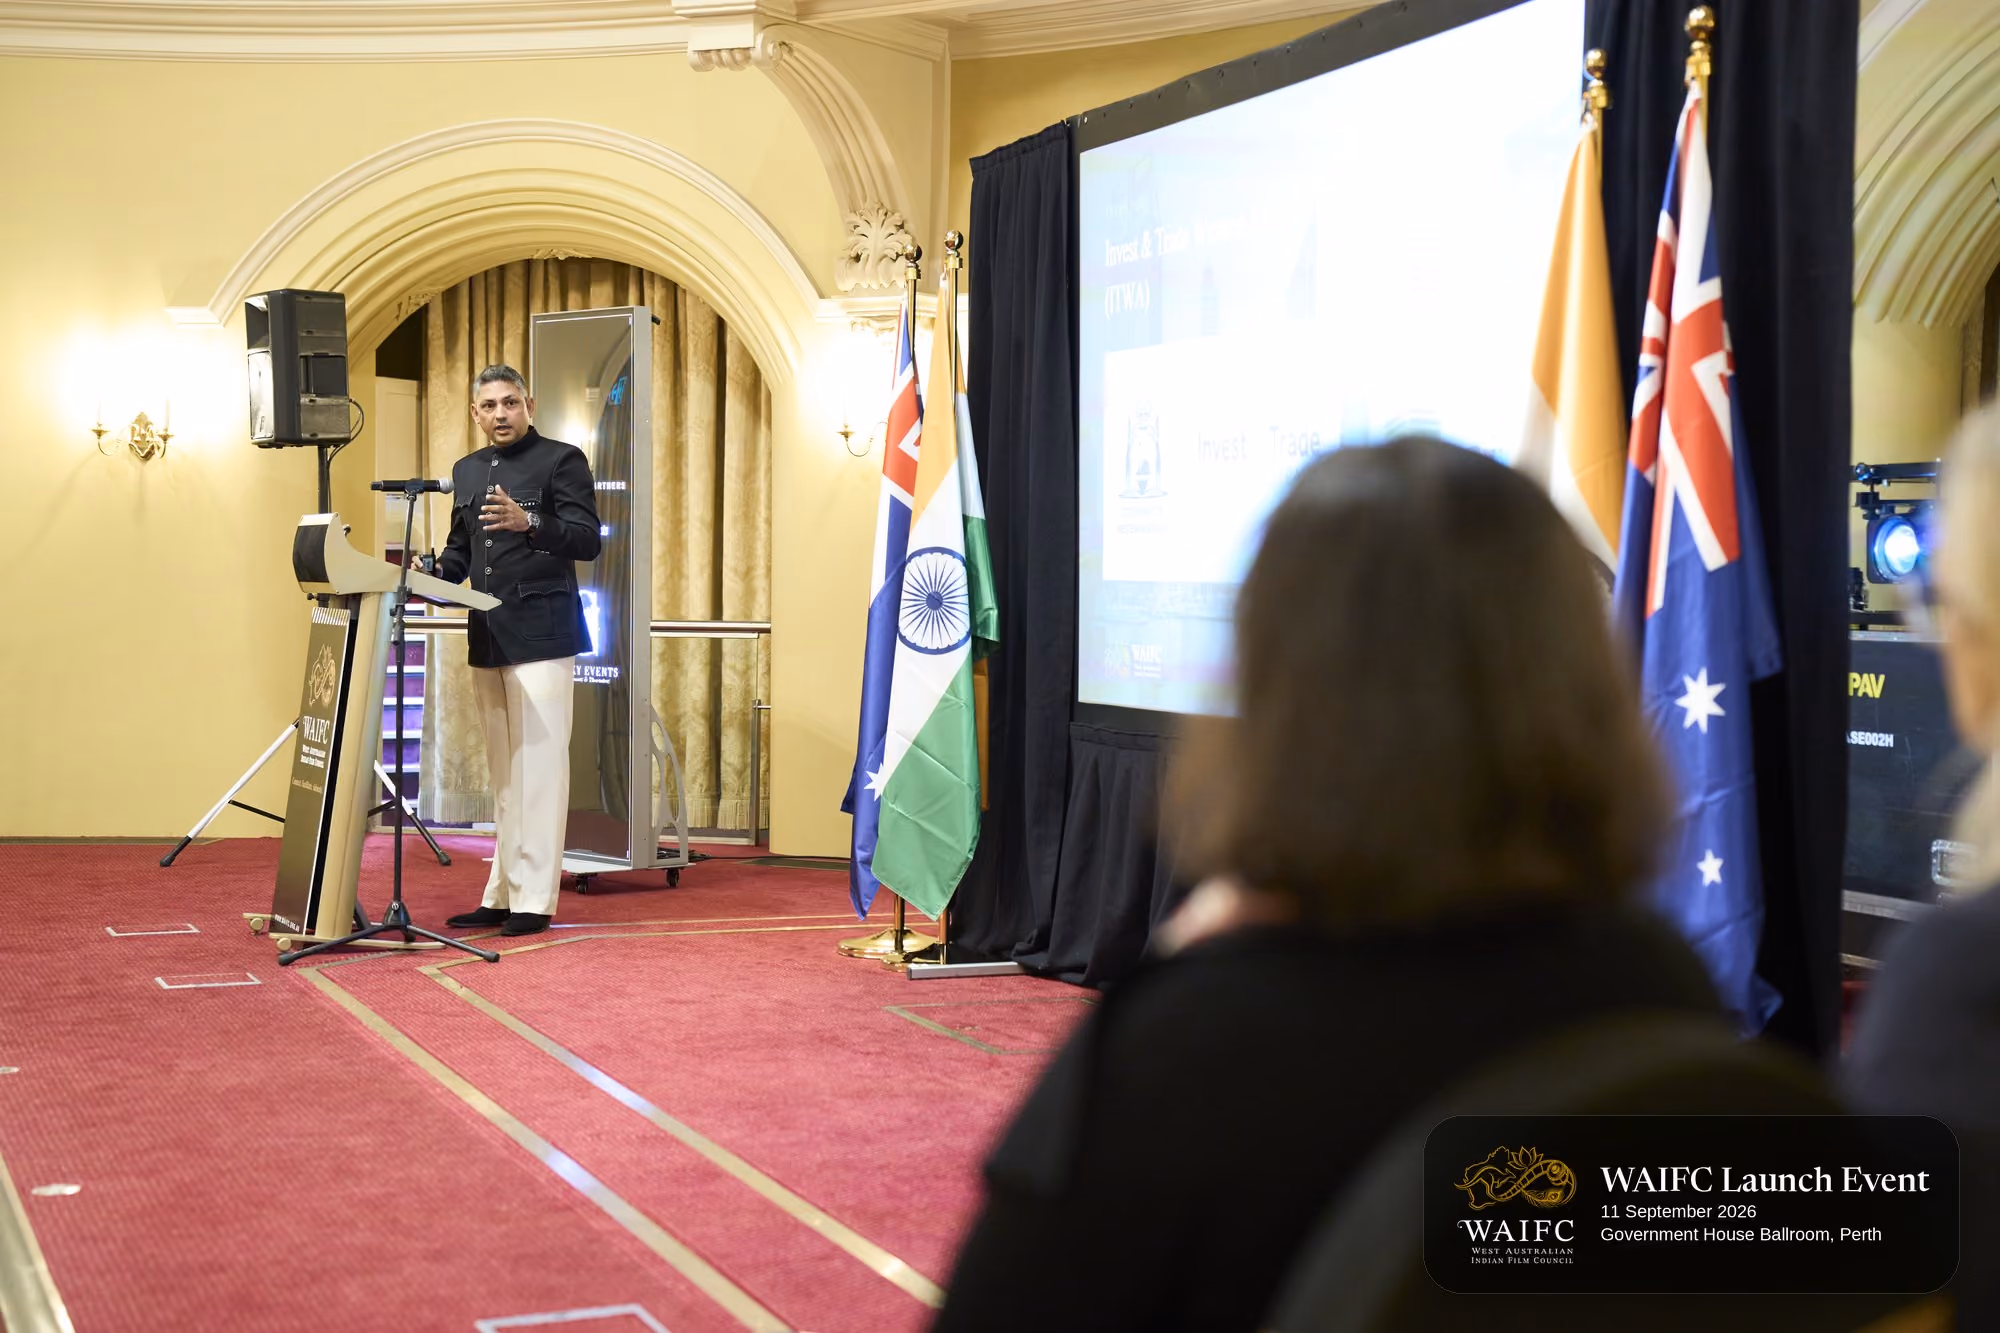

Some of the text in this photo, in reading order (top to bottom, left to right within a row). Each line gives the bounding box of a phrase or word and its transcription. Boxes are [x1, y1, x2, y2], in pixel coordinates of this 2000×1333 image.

[1105, 238, 1138, 267] Invest
[1140, 229, 1152, 259] &
[1105, 279, 1151, 320] (ITWA)
[1198, 430, 1248, 463] Invest
[584, 665, 619, 678] EVENTS
[1848, 672, 1885, 698] PAV
[303, 716, 330, 744] WAIFC
